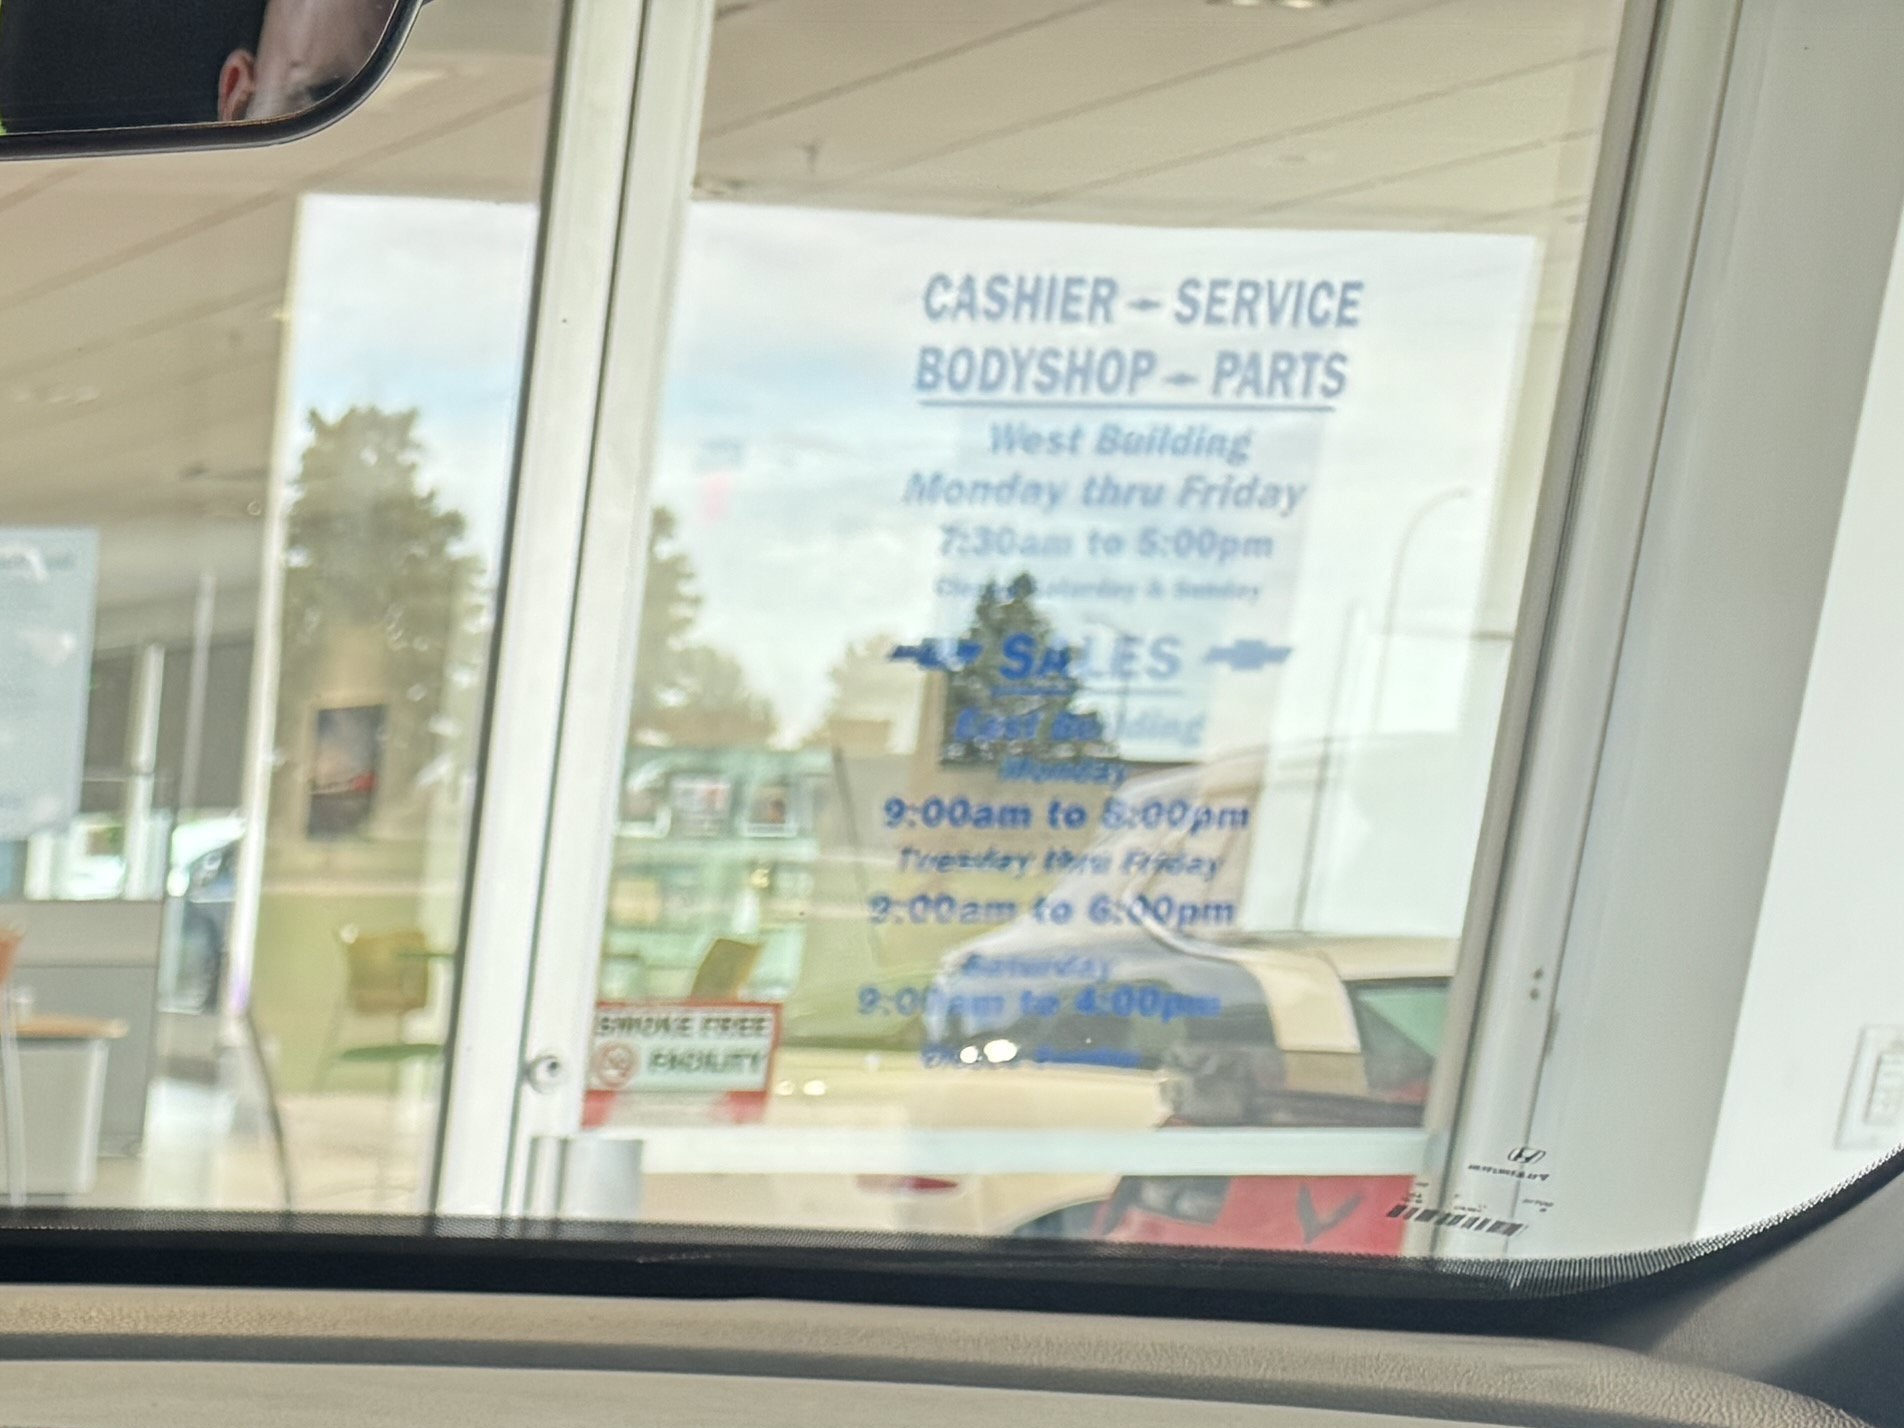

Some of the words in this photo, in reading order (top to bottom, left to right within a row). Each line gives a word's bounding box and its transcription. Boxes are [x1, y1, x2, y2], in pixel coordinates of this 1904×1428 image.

[923, 273, 1119, 324] CASHIER
[1174, 277, 1365, 328] SERVICE
[915, 345, 1158, 394] BODYSHOP
[1212, 350, 1349, 398] PARTS
[989, 424, 1084, 456] West
[1095, 424, 1253, 465] Building
[903, 472, 1065, 511] Monday
[1083, 475, 1165, 507] thru
[1177, 475, 1307, 517] Friday
[1088, 527, 1124, 557] to
[999, 633, 1183, 680] SALES
[883, 797, 1033, 830] 9:00am
[1048, 800, 1087, 830] to
[867, 893, 1018, 925] 9:00am
[1034, 895, 1073, 925] to
[1087, 895, 1235, 928] 6:00pm
[1020, 990, 1060, 1018] to
